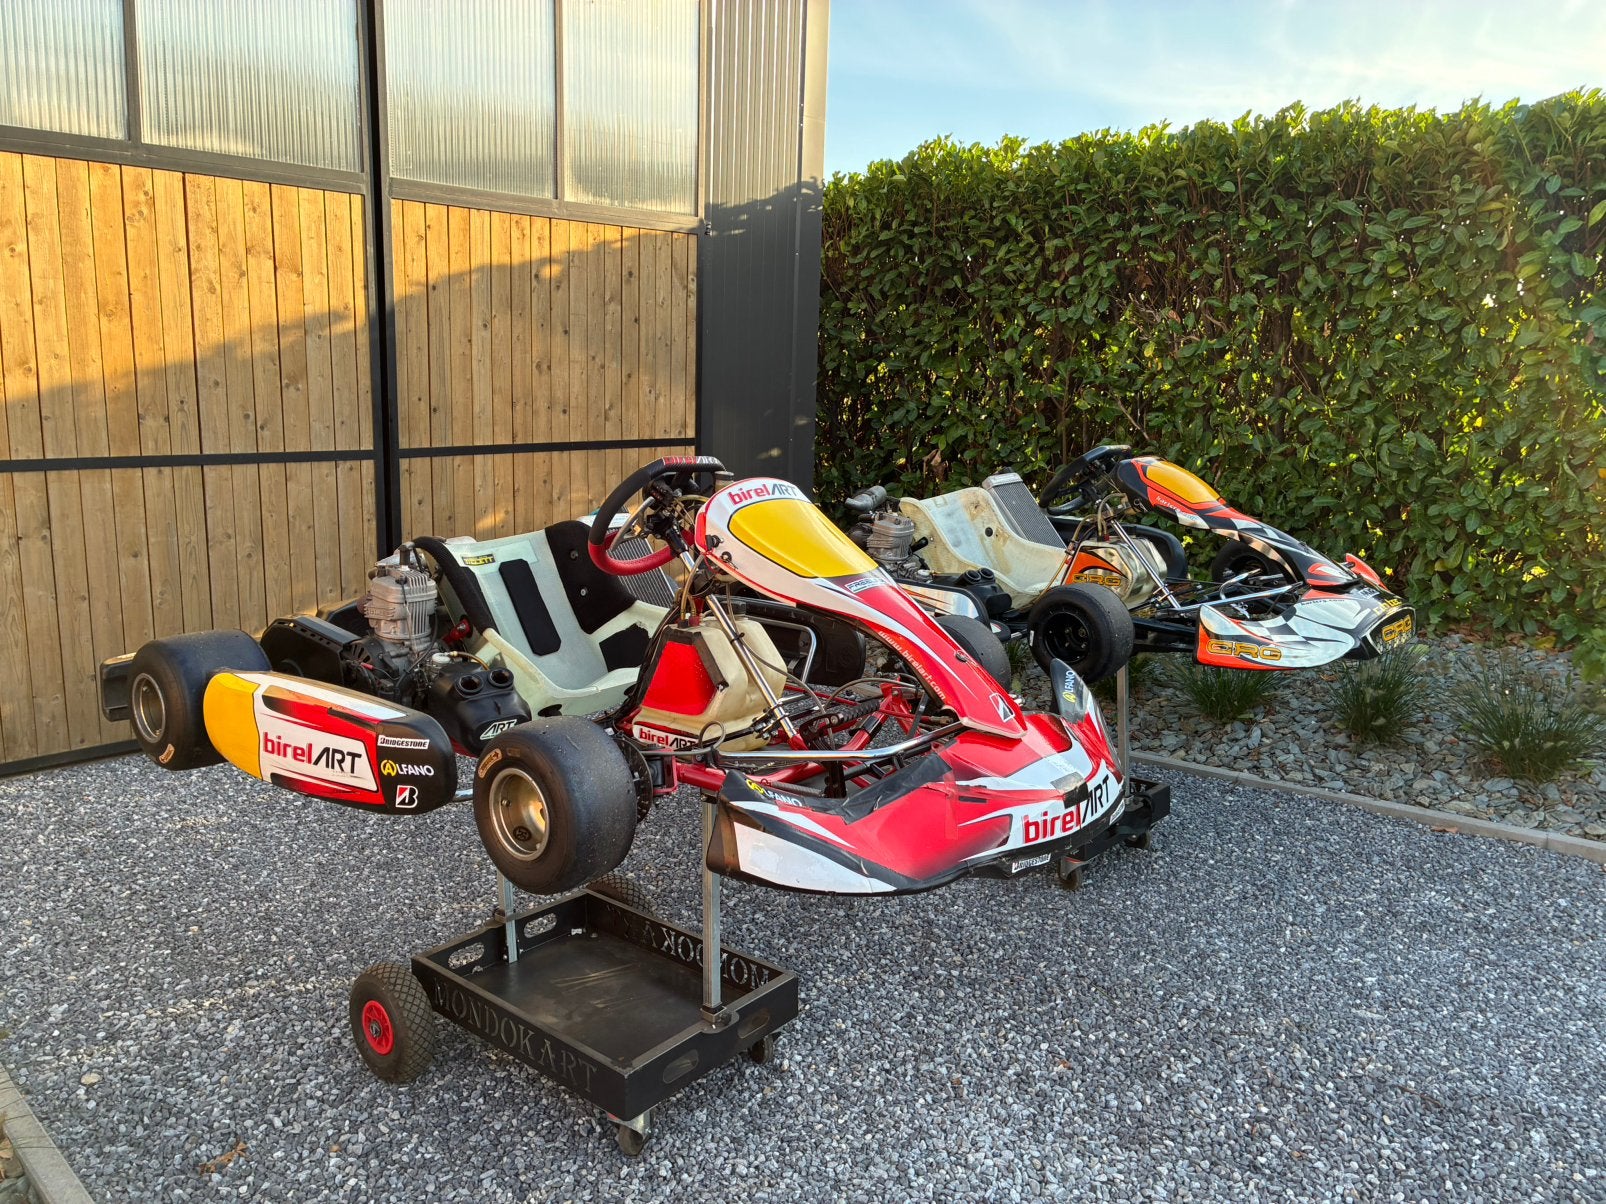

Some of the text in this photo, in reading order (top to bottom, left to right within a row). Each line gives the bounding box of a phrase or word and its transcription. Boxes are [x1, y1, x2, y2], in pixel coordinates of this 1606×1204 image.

[728, 483, 797, 506] birelART
[1206, 639, 1283, 661] CRG
[878, 631, 946, 700] www.birelart.com
[483, 720, 516, 737] ART
[638, 727, 697, 749] birelART
[379, 736, 429, 748] BRIDGESTONE
[262, 732, 362, 775] birelART
[380, 759, 435, 777] ALFANO
[1023, 774, 1109, 844] birelART
[434, 978, 598, 1092] MONDOKART
